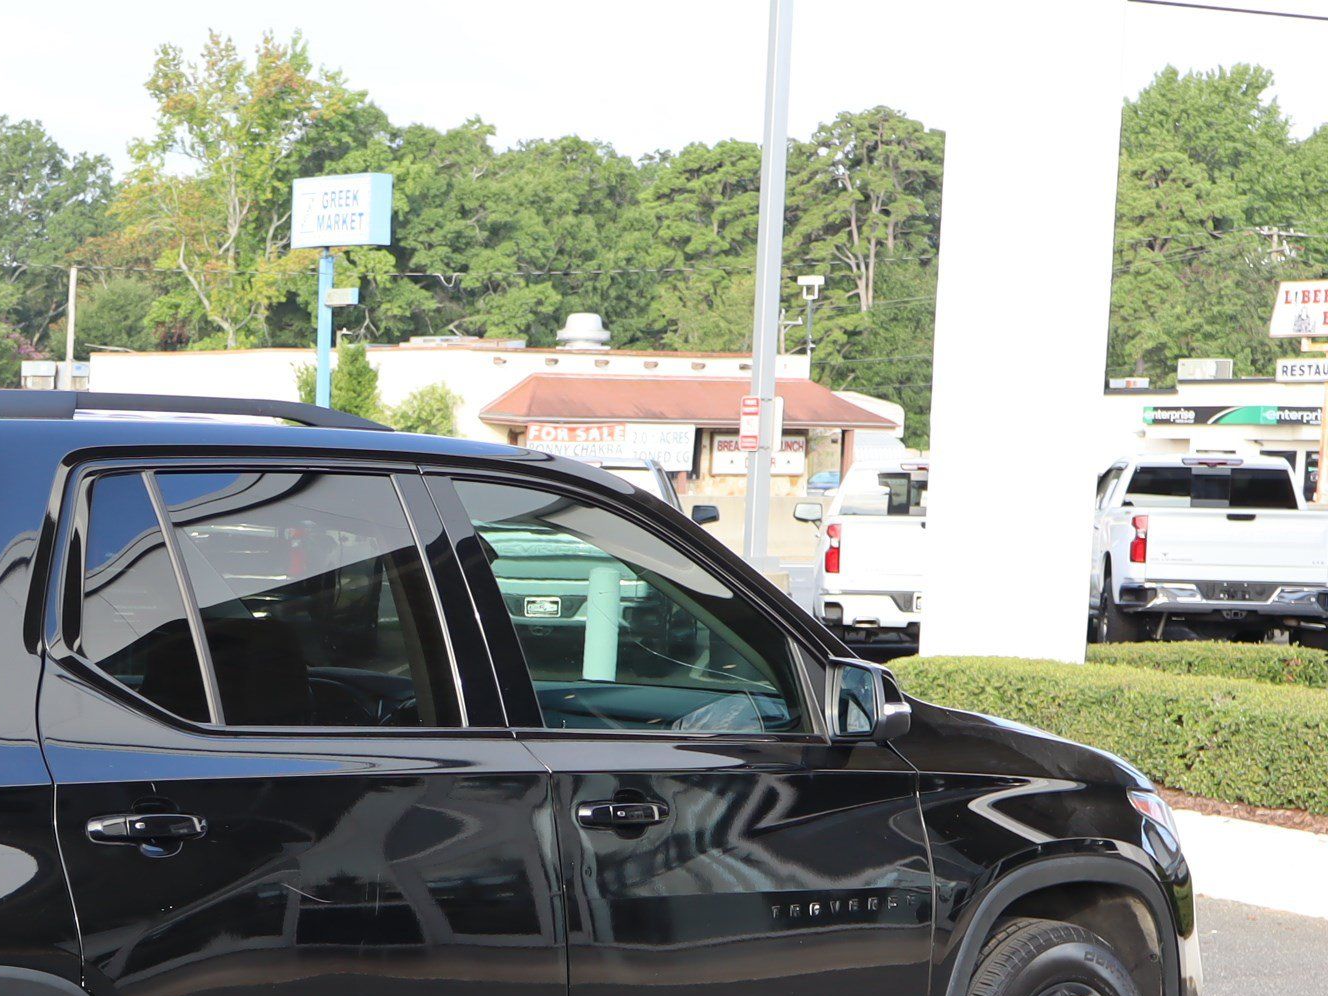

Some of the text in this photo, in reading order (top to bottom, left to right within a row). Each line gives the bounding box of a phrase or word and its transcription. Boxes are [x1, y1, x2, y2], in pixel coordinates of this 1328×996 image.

[322, 189, 359, 209] GREEK
[316, 212, 364, 232] MARKET
[1263, 408, 1322, 423] enterpri
[528, 426, 625, 442] FOR SALE
[659, 431, 690, 445] ACRES
